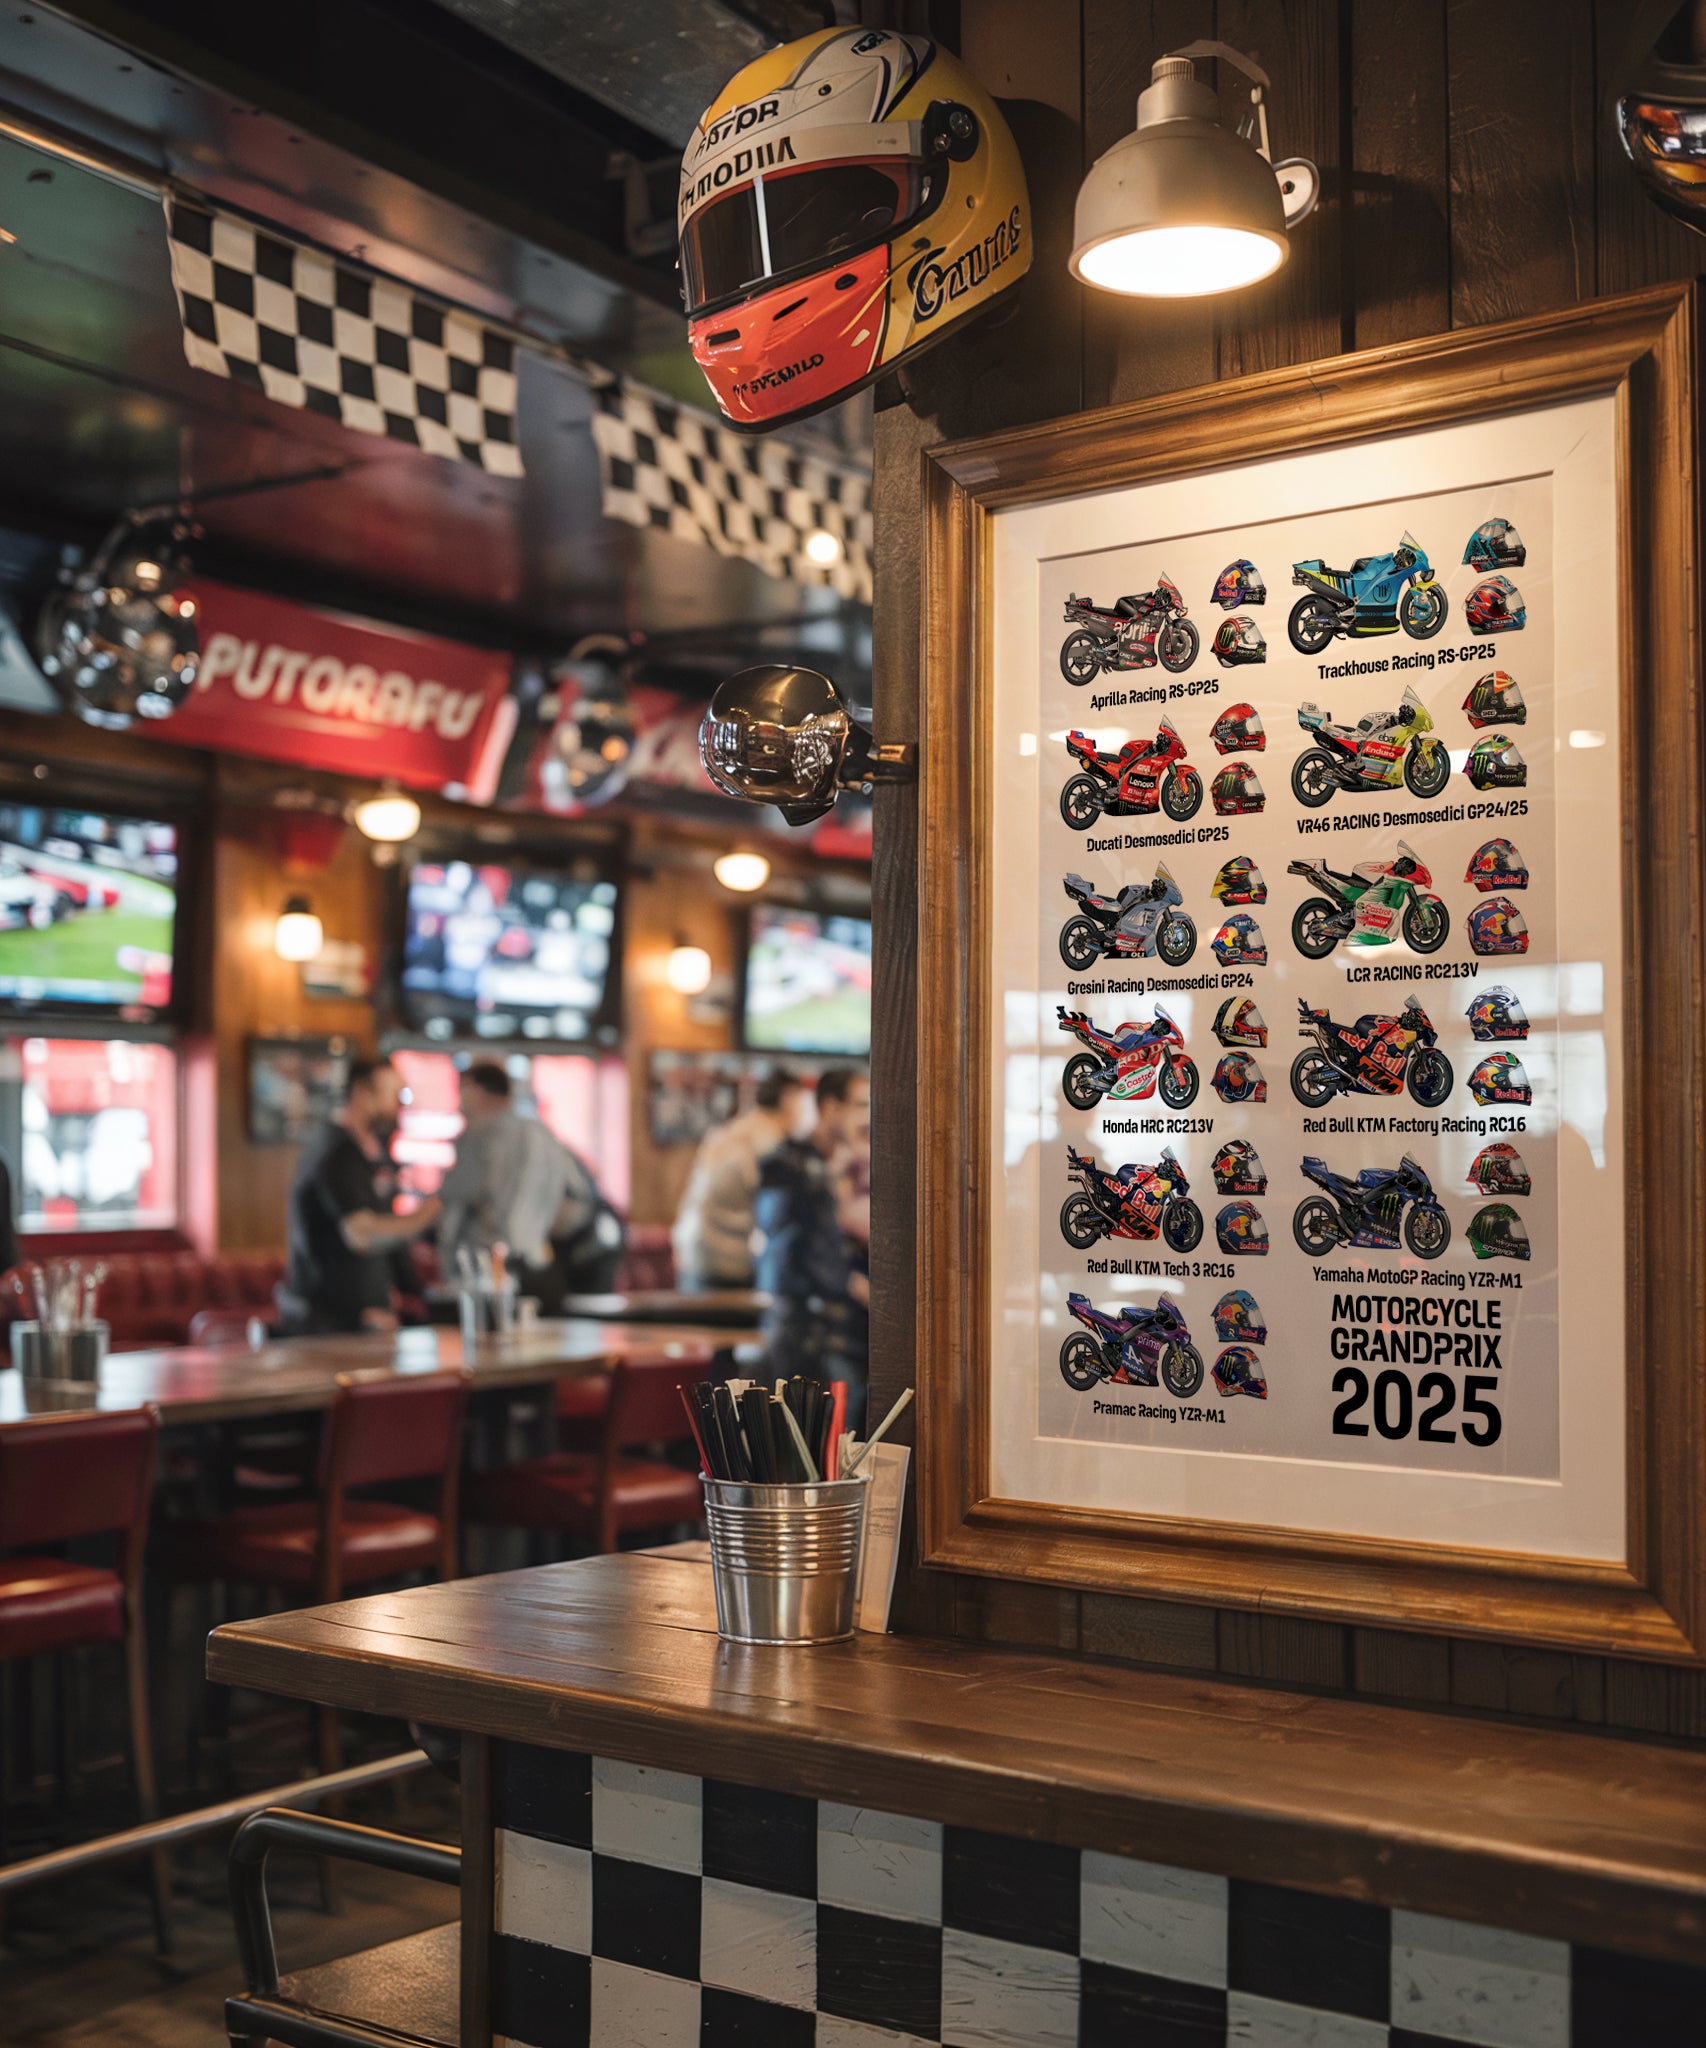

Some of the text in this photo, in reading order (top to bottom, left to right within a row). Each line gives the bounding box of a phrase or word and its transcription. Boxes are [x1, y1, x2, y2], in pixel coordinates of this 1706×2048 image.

[1318, 643, 1496, 679] Trackhouse Racing RS-GP25
[1129, 686, 1166, 703] Racing
[1169, 679, 1219, 699] RS-GP25
[1129, 776, 1156, 789] Lenovo
[1297, 800, 1528, 834] VR46 RACING Desmosedici GP24/25
[1087, 826, 1230, 853] Ducati Desmosedici GP25
[1067, 967, 1253, 995] Gresini Racing Desmosedici GP24
[1346, 962, 1479, 983] LCR RACING RC213V
[1371, 1042, 1406, 1076] Bull
[1359, 1062, 1399, 1093] KTM
[1102, 1119, 1214, 1134] Honda HRC RC213V
[1303, 1117, 1527, 1137] Red Bull KTM Factory Racing RC16
[1131, 1190, 1162, 1222] Bull
[1088, 1258, 1235, 1279] Red Bull KTM Tech 3 RC16
[1313, 1267, 1523, 1291] Yamaha MotoGP Racing YZR-M1
[1331, 1294, 1502, 1330] MOTORCYCLE
[1331, 1327, 1503, 1370] GRANDPRIX
[1093, 1400, 1226, 1424] Pramac Racing YZR-M1
[1331, 1366, 1502, 1448] 2025
